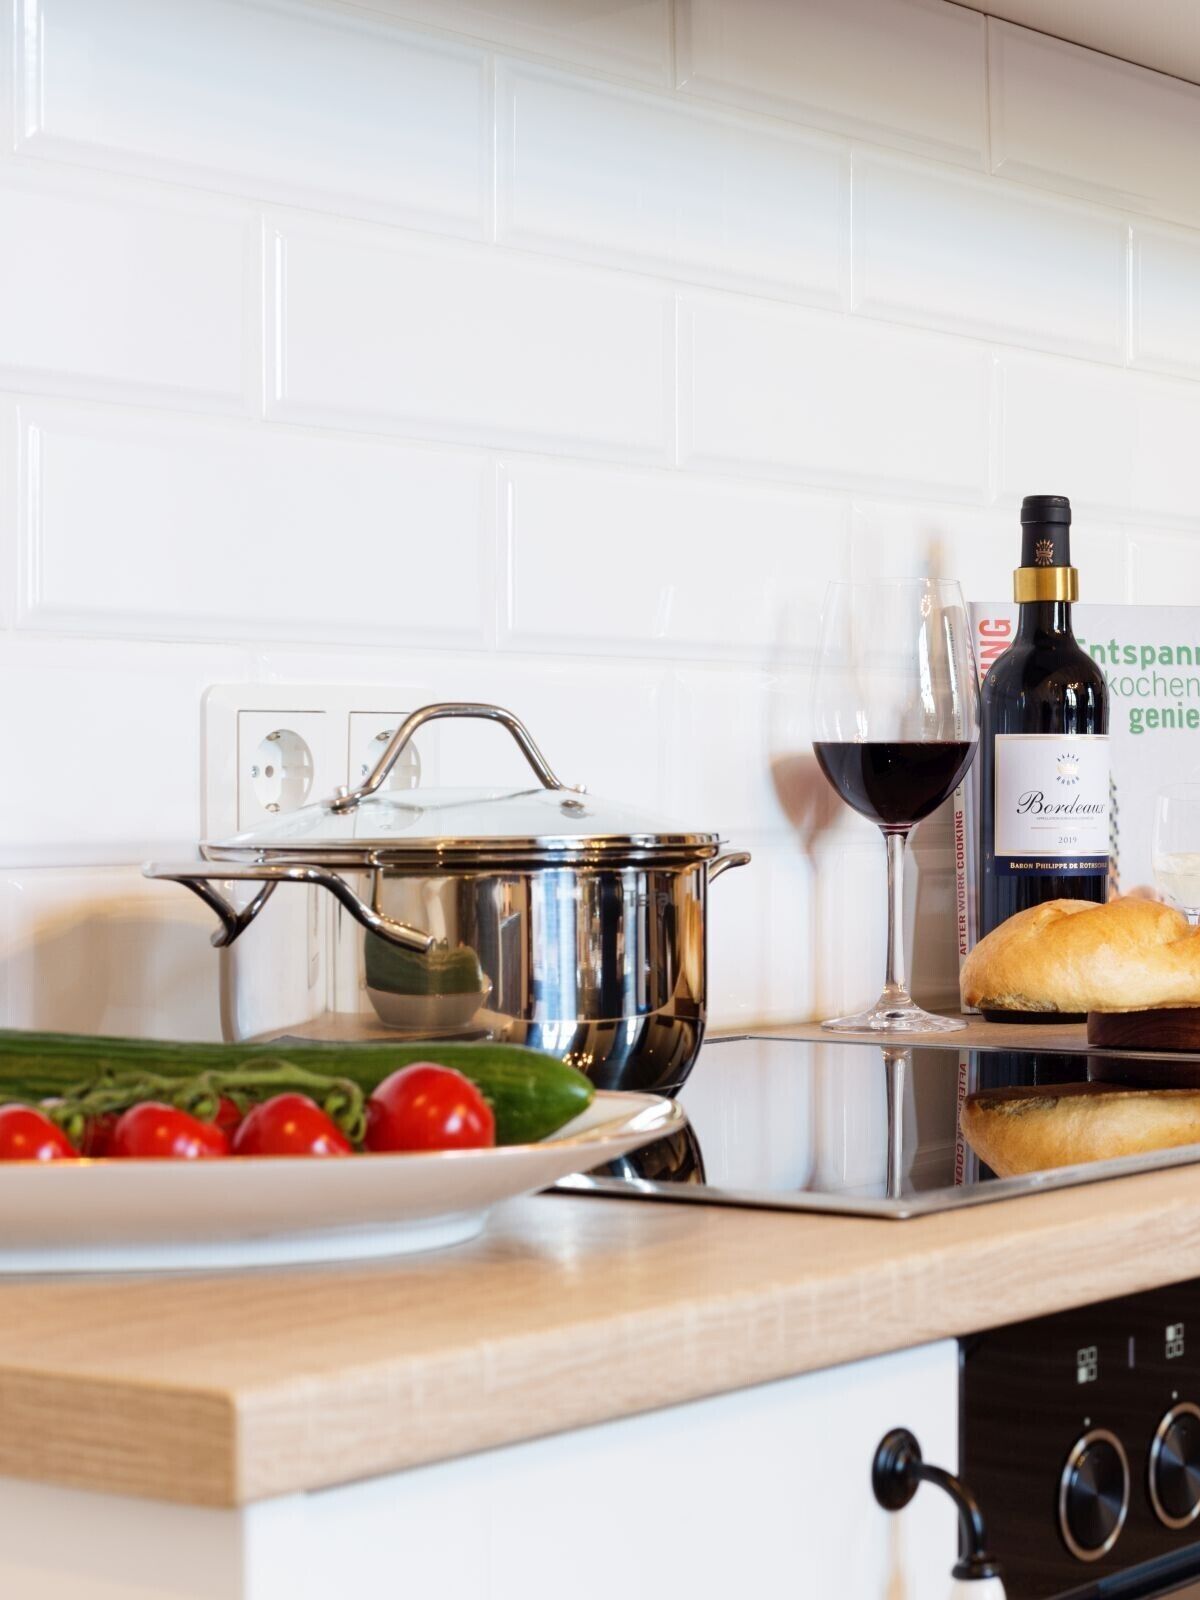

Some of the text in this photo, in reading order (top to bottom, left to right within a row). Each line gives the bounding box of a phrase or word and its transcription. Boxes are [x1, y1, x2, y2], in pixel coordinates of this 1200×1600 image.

[1105, 670, 1200, 697] kochen
[1016, 790, 1105, 815] Bordeaux
[1058, 836, 1077, 844] 2019
[955, 810, 967, 955] AFTER WORK COOKING
